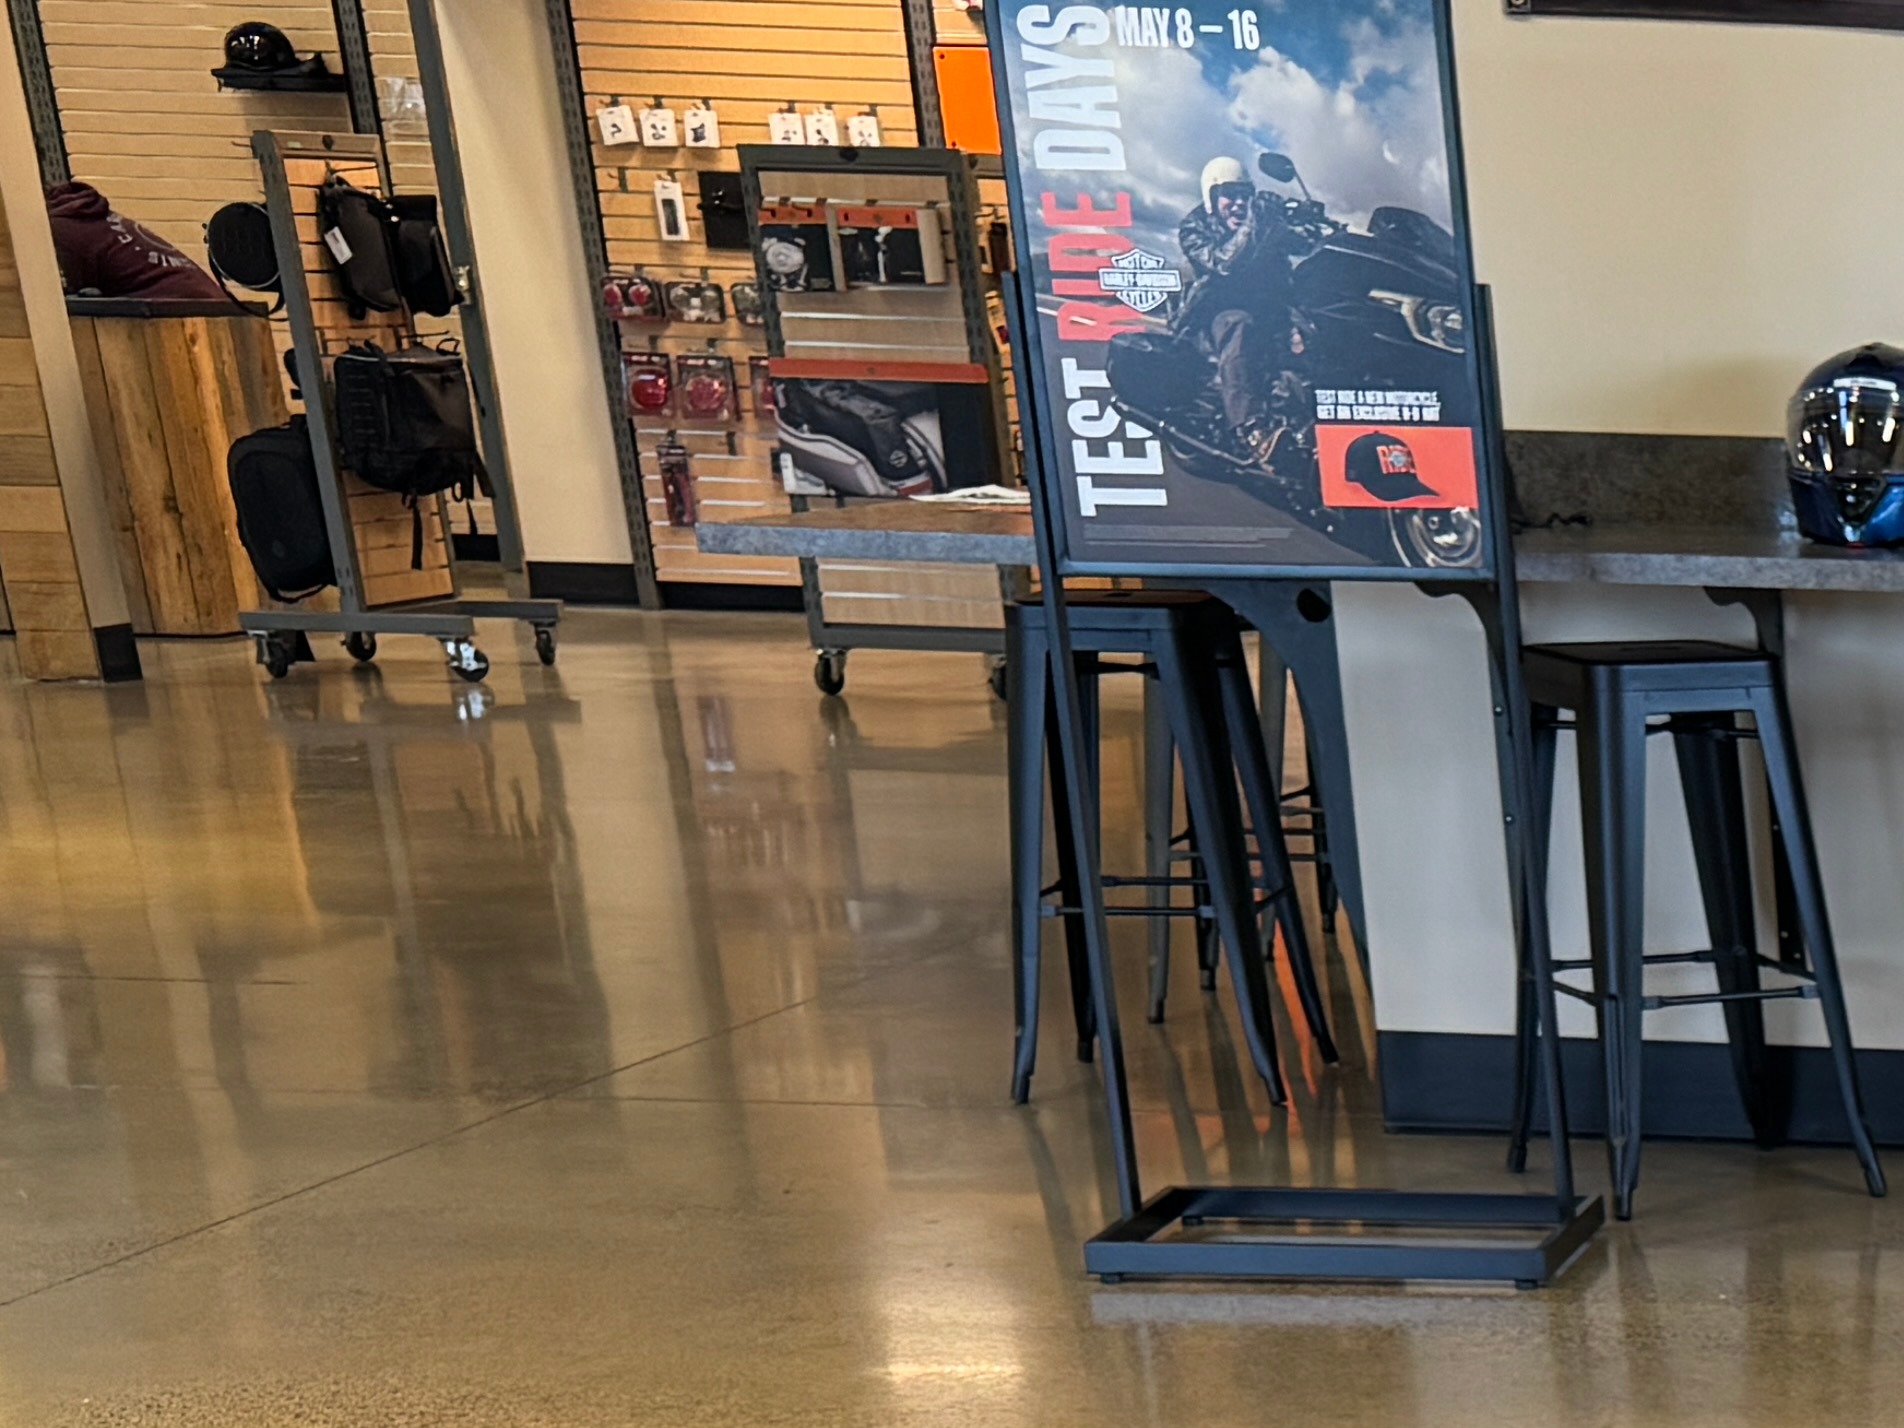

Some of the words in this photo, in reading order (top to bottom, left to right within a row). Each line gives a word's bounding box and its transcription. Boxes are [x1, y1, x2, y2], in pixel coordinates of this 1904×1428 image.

[1016, 4, 1127, 171] DAYS
[1114, 5, 1170, 48] MAY
[1175, 7, 1195, 49] 8
[1227, 9, 1261, 51] 16
[1041, 192, 1148, 342] RIDE
[1060, 357, 1169, 517] TEST
